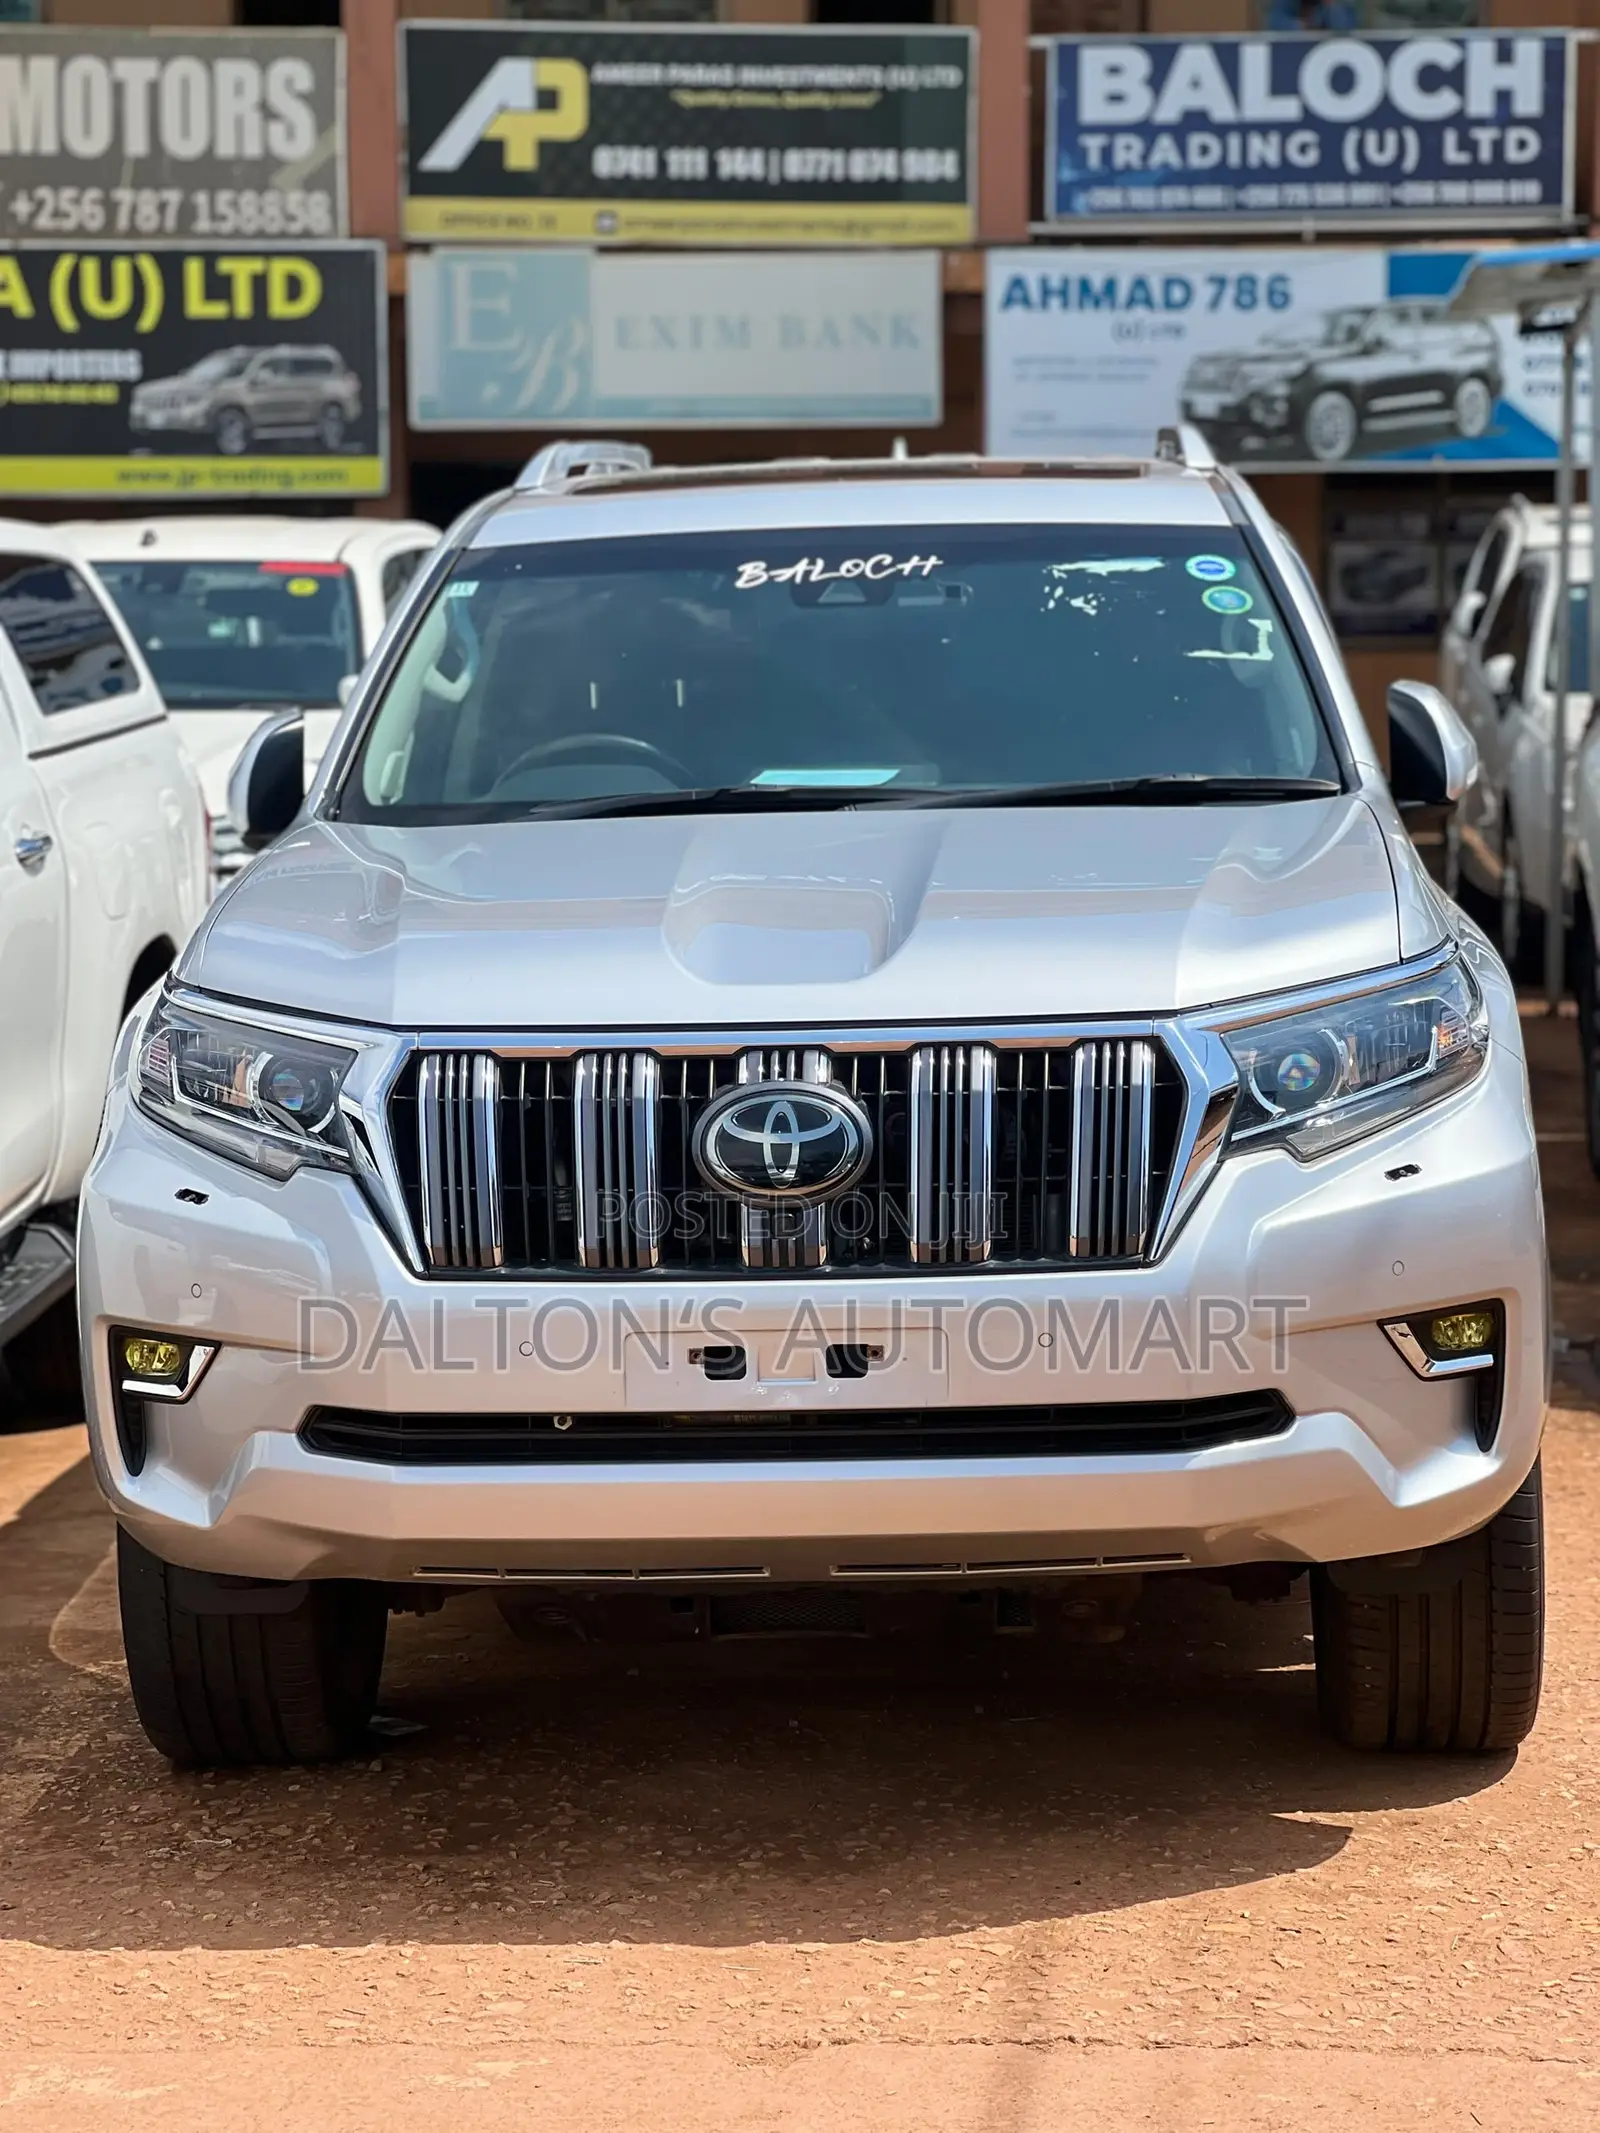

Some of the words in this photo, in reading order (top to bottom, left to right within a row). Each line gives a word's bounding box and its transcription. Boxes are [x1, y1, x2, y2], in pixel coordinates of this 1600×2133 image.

[1077, 37, 1544, 126] BALOCH
[0, 55, 316, 162] MOTORS
[1077, 132, 1321, 170] TRADING
[1342, 127, 1420, 174] (U)
[1443, 126, 1542, 165] LTD
[10, 185, 106, 231] +256
[110, 187, 183, 234] 787
[49, 253, 165, 333] (U)
[184, 256, 323, 320] LTD
[1000, 272, 1195, 313] AHMAD
[1205, 272, 1293, 312] 786
[613, 313, 752, 351] EXIM
[778, 313, 921, 350] BANK
[735, 553, 944, 588] BALOCH
